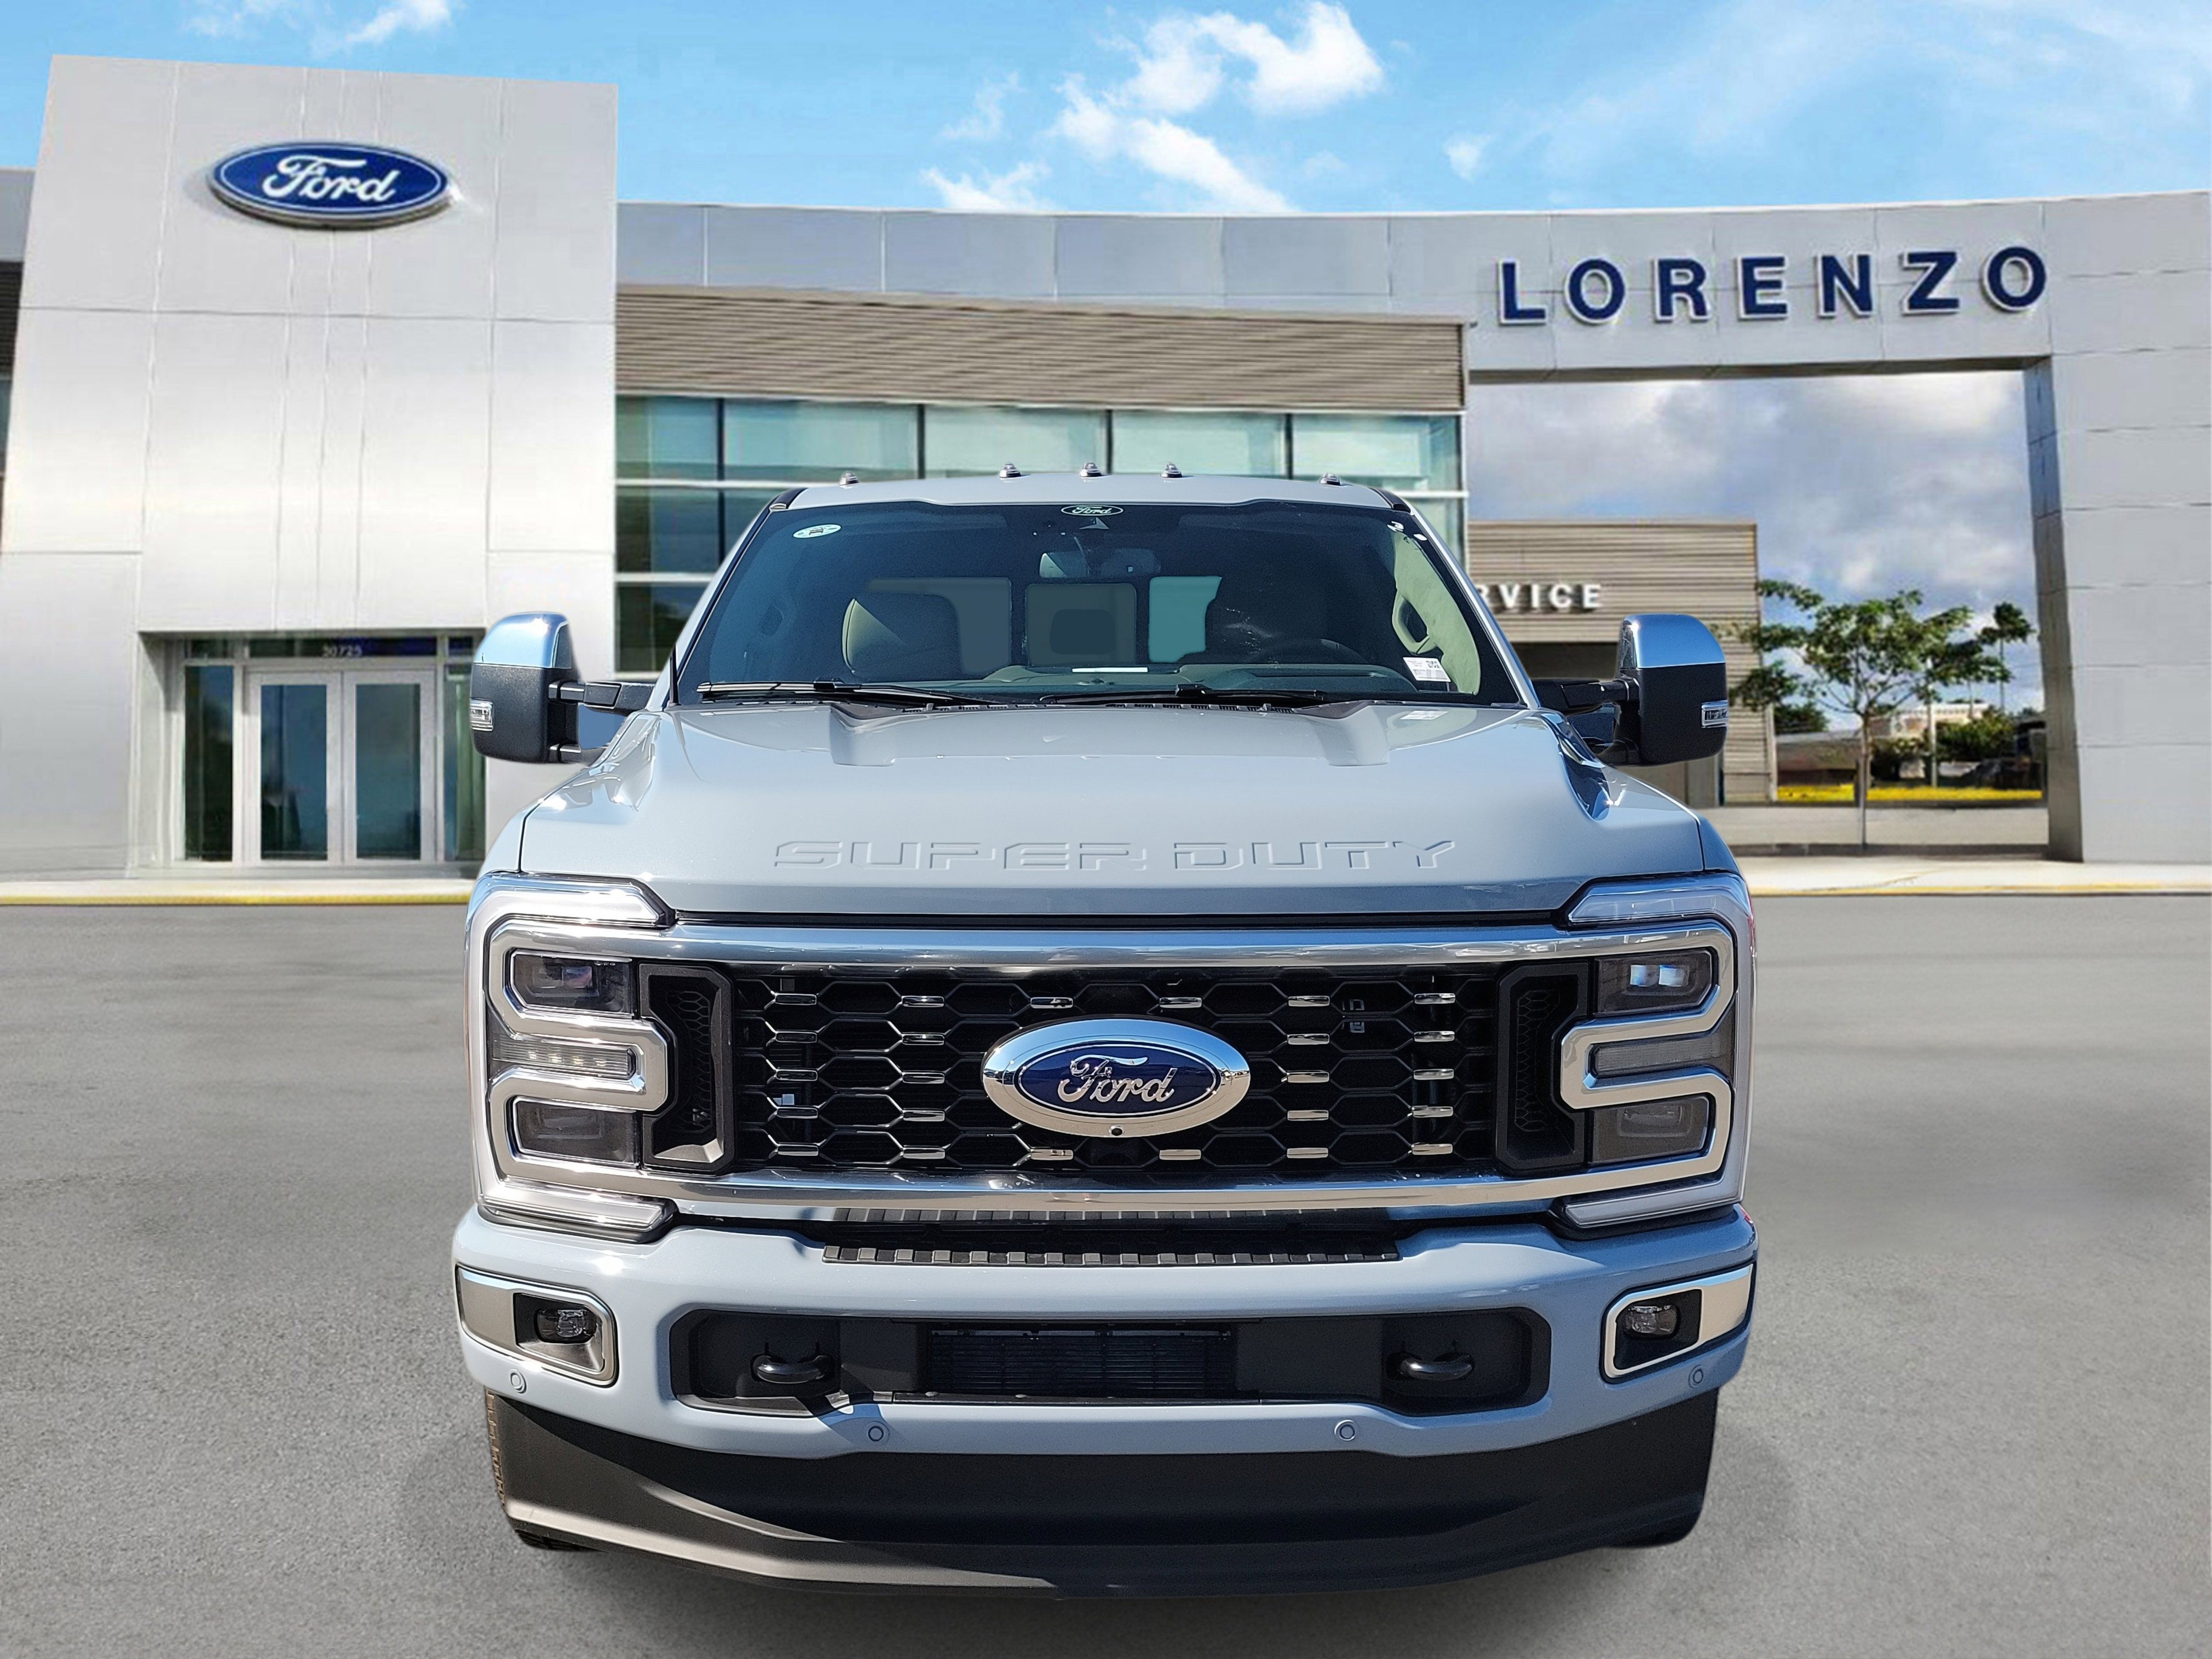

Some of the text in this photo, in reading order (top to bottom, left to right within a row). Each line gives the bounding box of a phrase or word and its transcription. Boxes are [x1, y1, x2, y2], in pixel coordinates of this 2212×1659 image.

[262, 155, 400, 201] Ford
[1497, 246, 2047, 324] LORENZO
[1072, 506, 1112, 514] Ford
[775, 840, 1455, 871] SUPER DUTY
[1057, 1054, 1178, 1103] Ford
